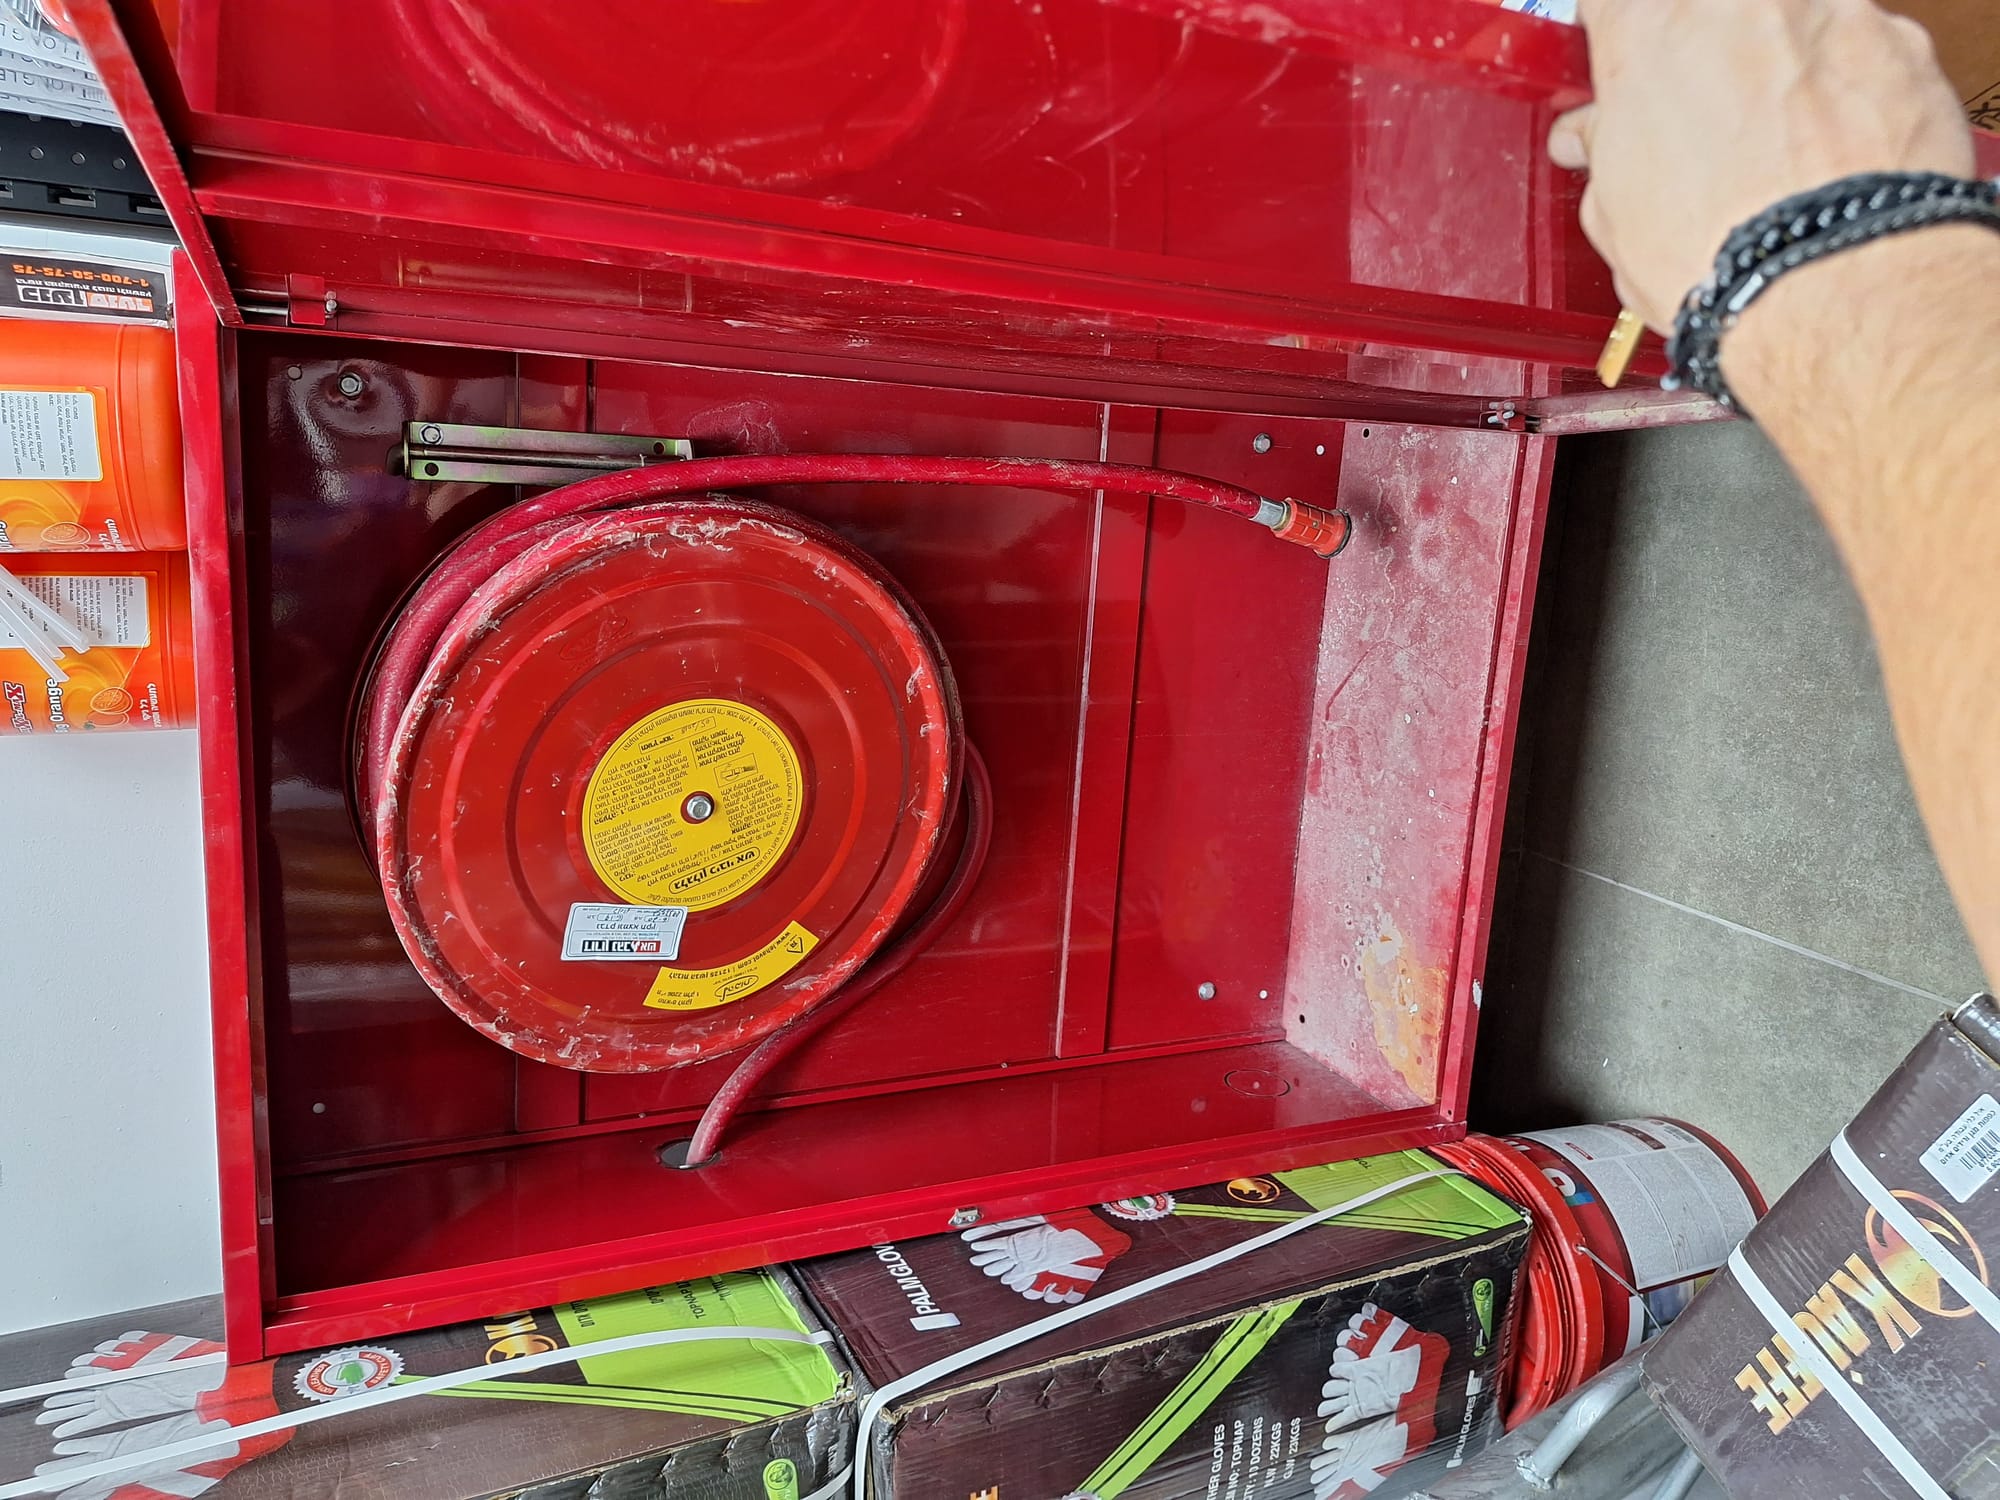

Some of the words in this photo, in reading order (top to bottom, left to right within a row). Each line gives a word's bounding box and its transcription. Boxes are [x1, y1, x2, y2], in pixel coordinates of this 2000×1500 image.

[11, 263, 149, 286] 1-700-50-75-75
[673, 868, 707, 891] גלגלון
[708, 858, 733, 874] כיבוי
[736, 850, 754, 863] אש
[583, 939, 607, 952] דורון
[737, 931, 791, 969] www.lehavot.com
[710, 968, 730, 976] 12125
[1969, 1126, 1979, 1137] מגן
[1978, 1109, 1995, 1127] כפפות
[1940, 1151, 1954, 1164] אדום
[871, 1246, 913, 1273] GLOV
[679, 1288, 706, 1319] TOPNAP
[1459, 1395, 1477, 1433] GLOVES
[1209, 1423, 1227, 1472] GLOVES
[1229, 1419, 1246, 1467] TOPNAP
[1248, 1416, 1265, 1465] DOZENS
[1286, 1417, 1301, 1453] 23KGS
[1453, 1433, 1467, 1459] PALM
[1227, 1467, 1240, 1489] NO:
